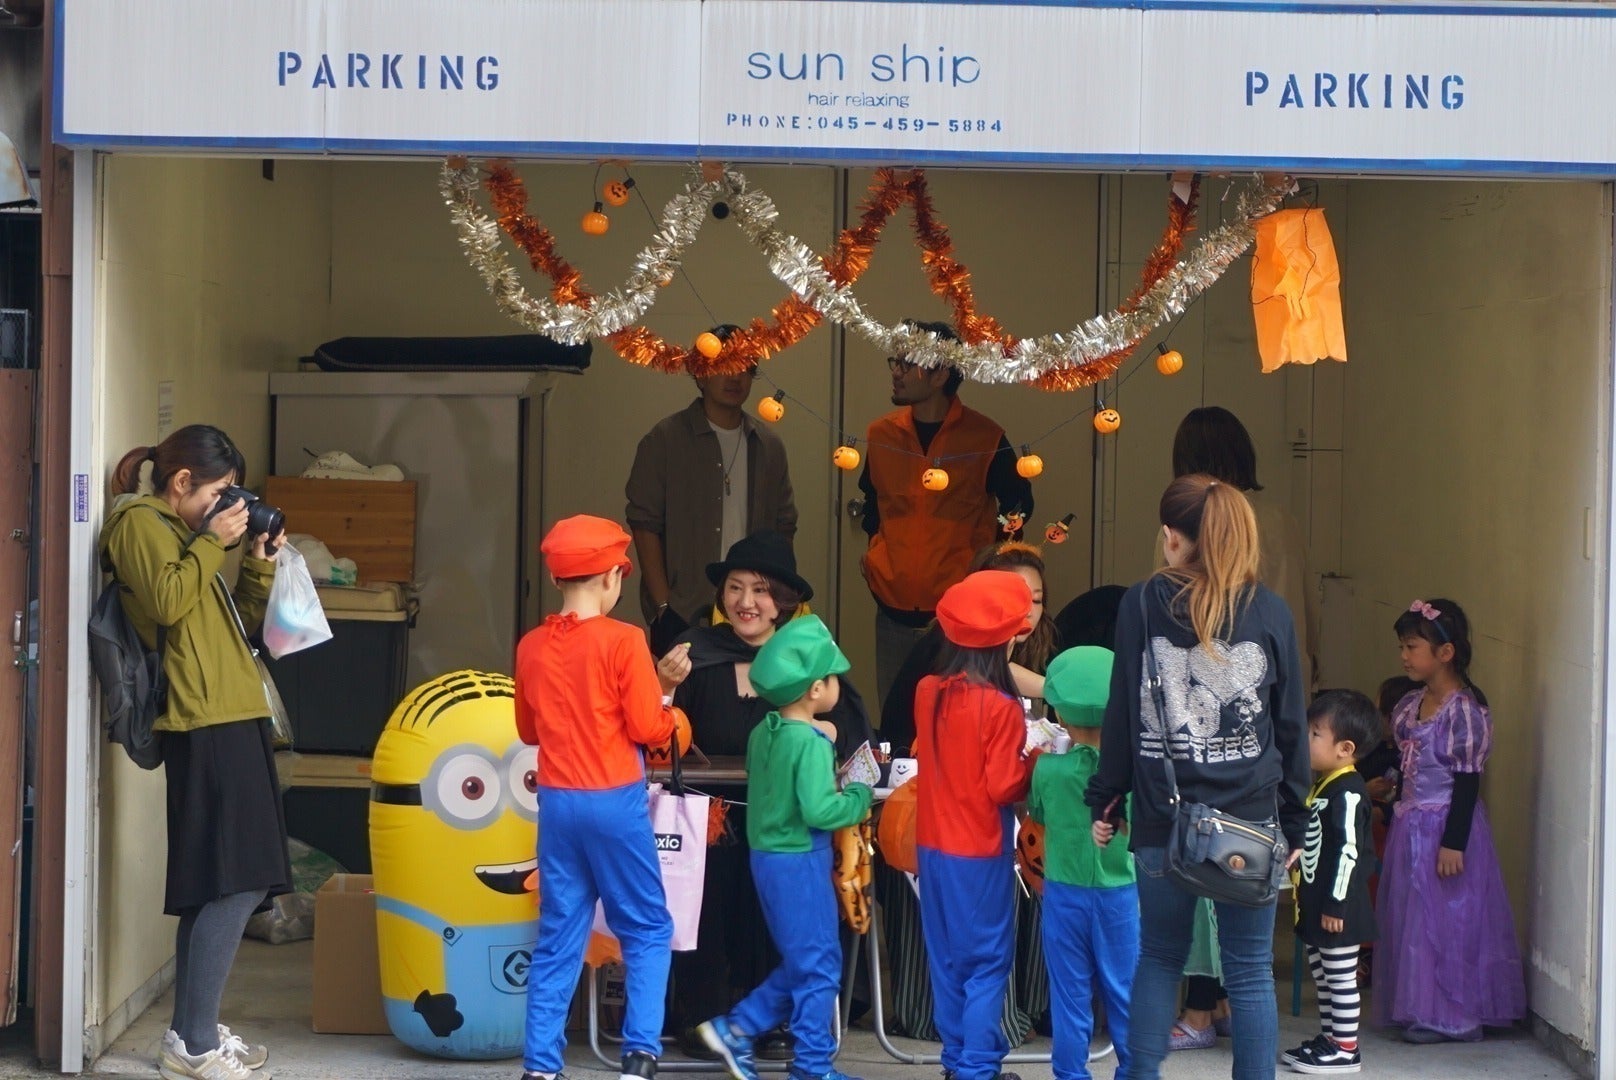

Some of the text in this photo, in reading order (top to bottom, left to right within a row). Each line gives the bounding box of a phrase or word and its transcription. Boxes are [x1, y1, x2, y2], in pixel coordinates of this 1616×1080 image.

[277, 51, 500, 91] PARKING
[747, 43, 981, 87] sun ship
[807, 92, 910, 108] hair relaxing
[1245, 70, 1466, 111] PARKING
